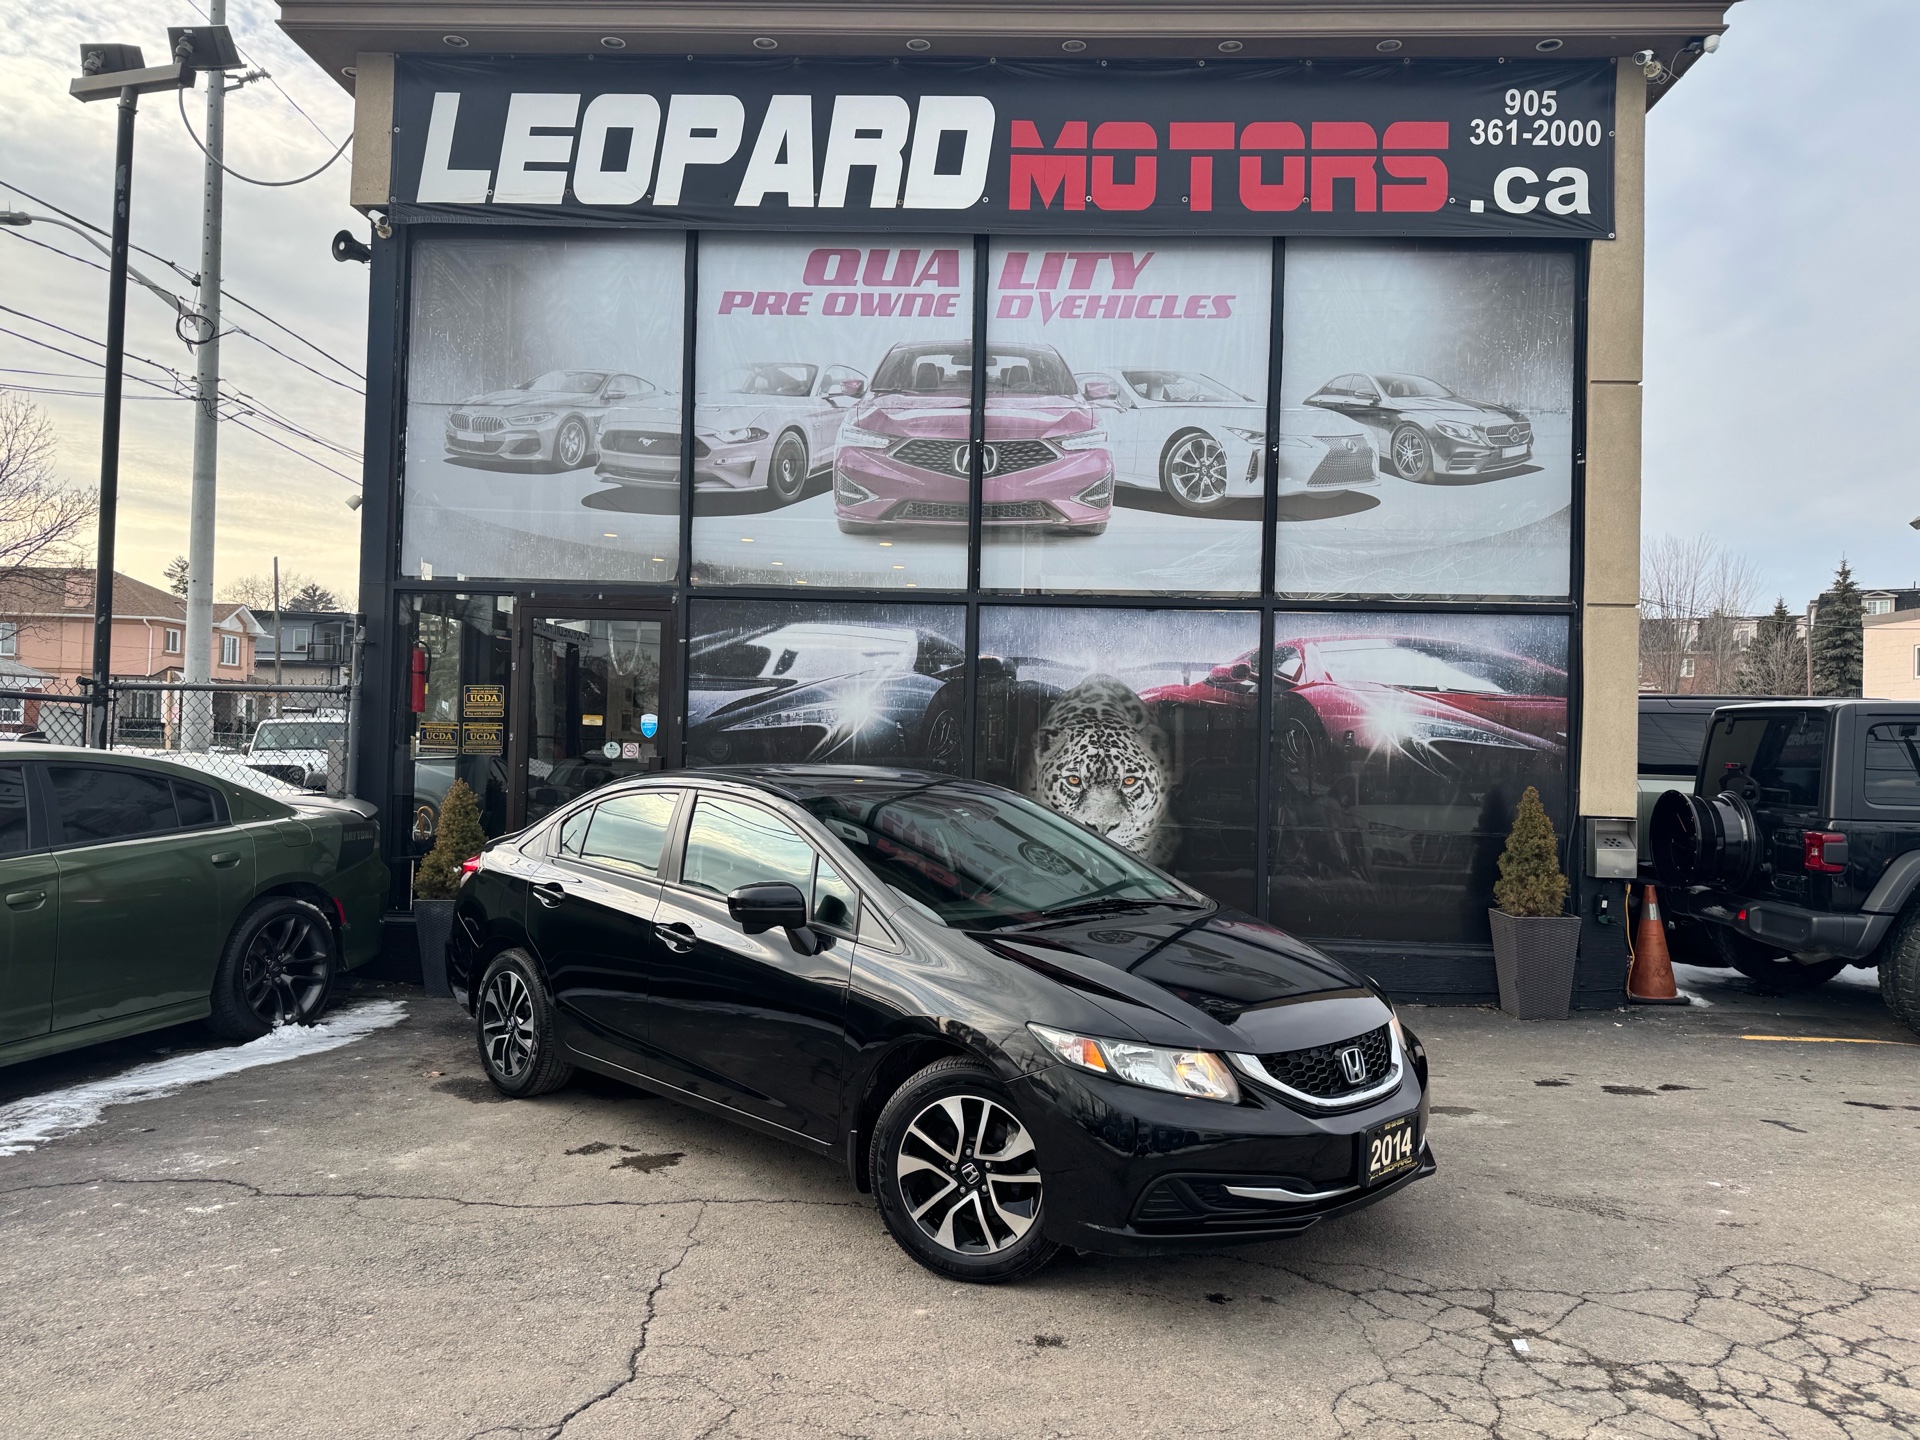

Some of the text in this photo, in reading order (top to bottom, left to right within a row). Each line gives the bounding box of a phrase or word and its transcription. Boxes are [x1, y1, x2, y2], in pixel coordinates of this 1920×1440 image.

[1504, 88, 1558, 117] 905
[1469, 118, 1602, 147] 361-2000
[416, 91, 1450, 213] LEOPARD MOTORS
[1469, 166, 1592, 216] .ca
[718, 291, 812, 316] PRE
[470, 694, 499, 702] UCDA
[426, 732, 453, 740] UCDA
[344, 830, 374, 841] DAYTONA
[1370, 1126, 1412, 1172] 2014
